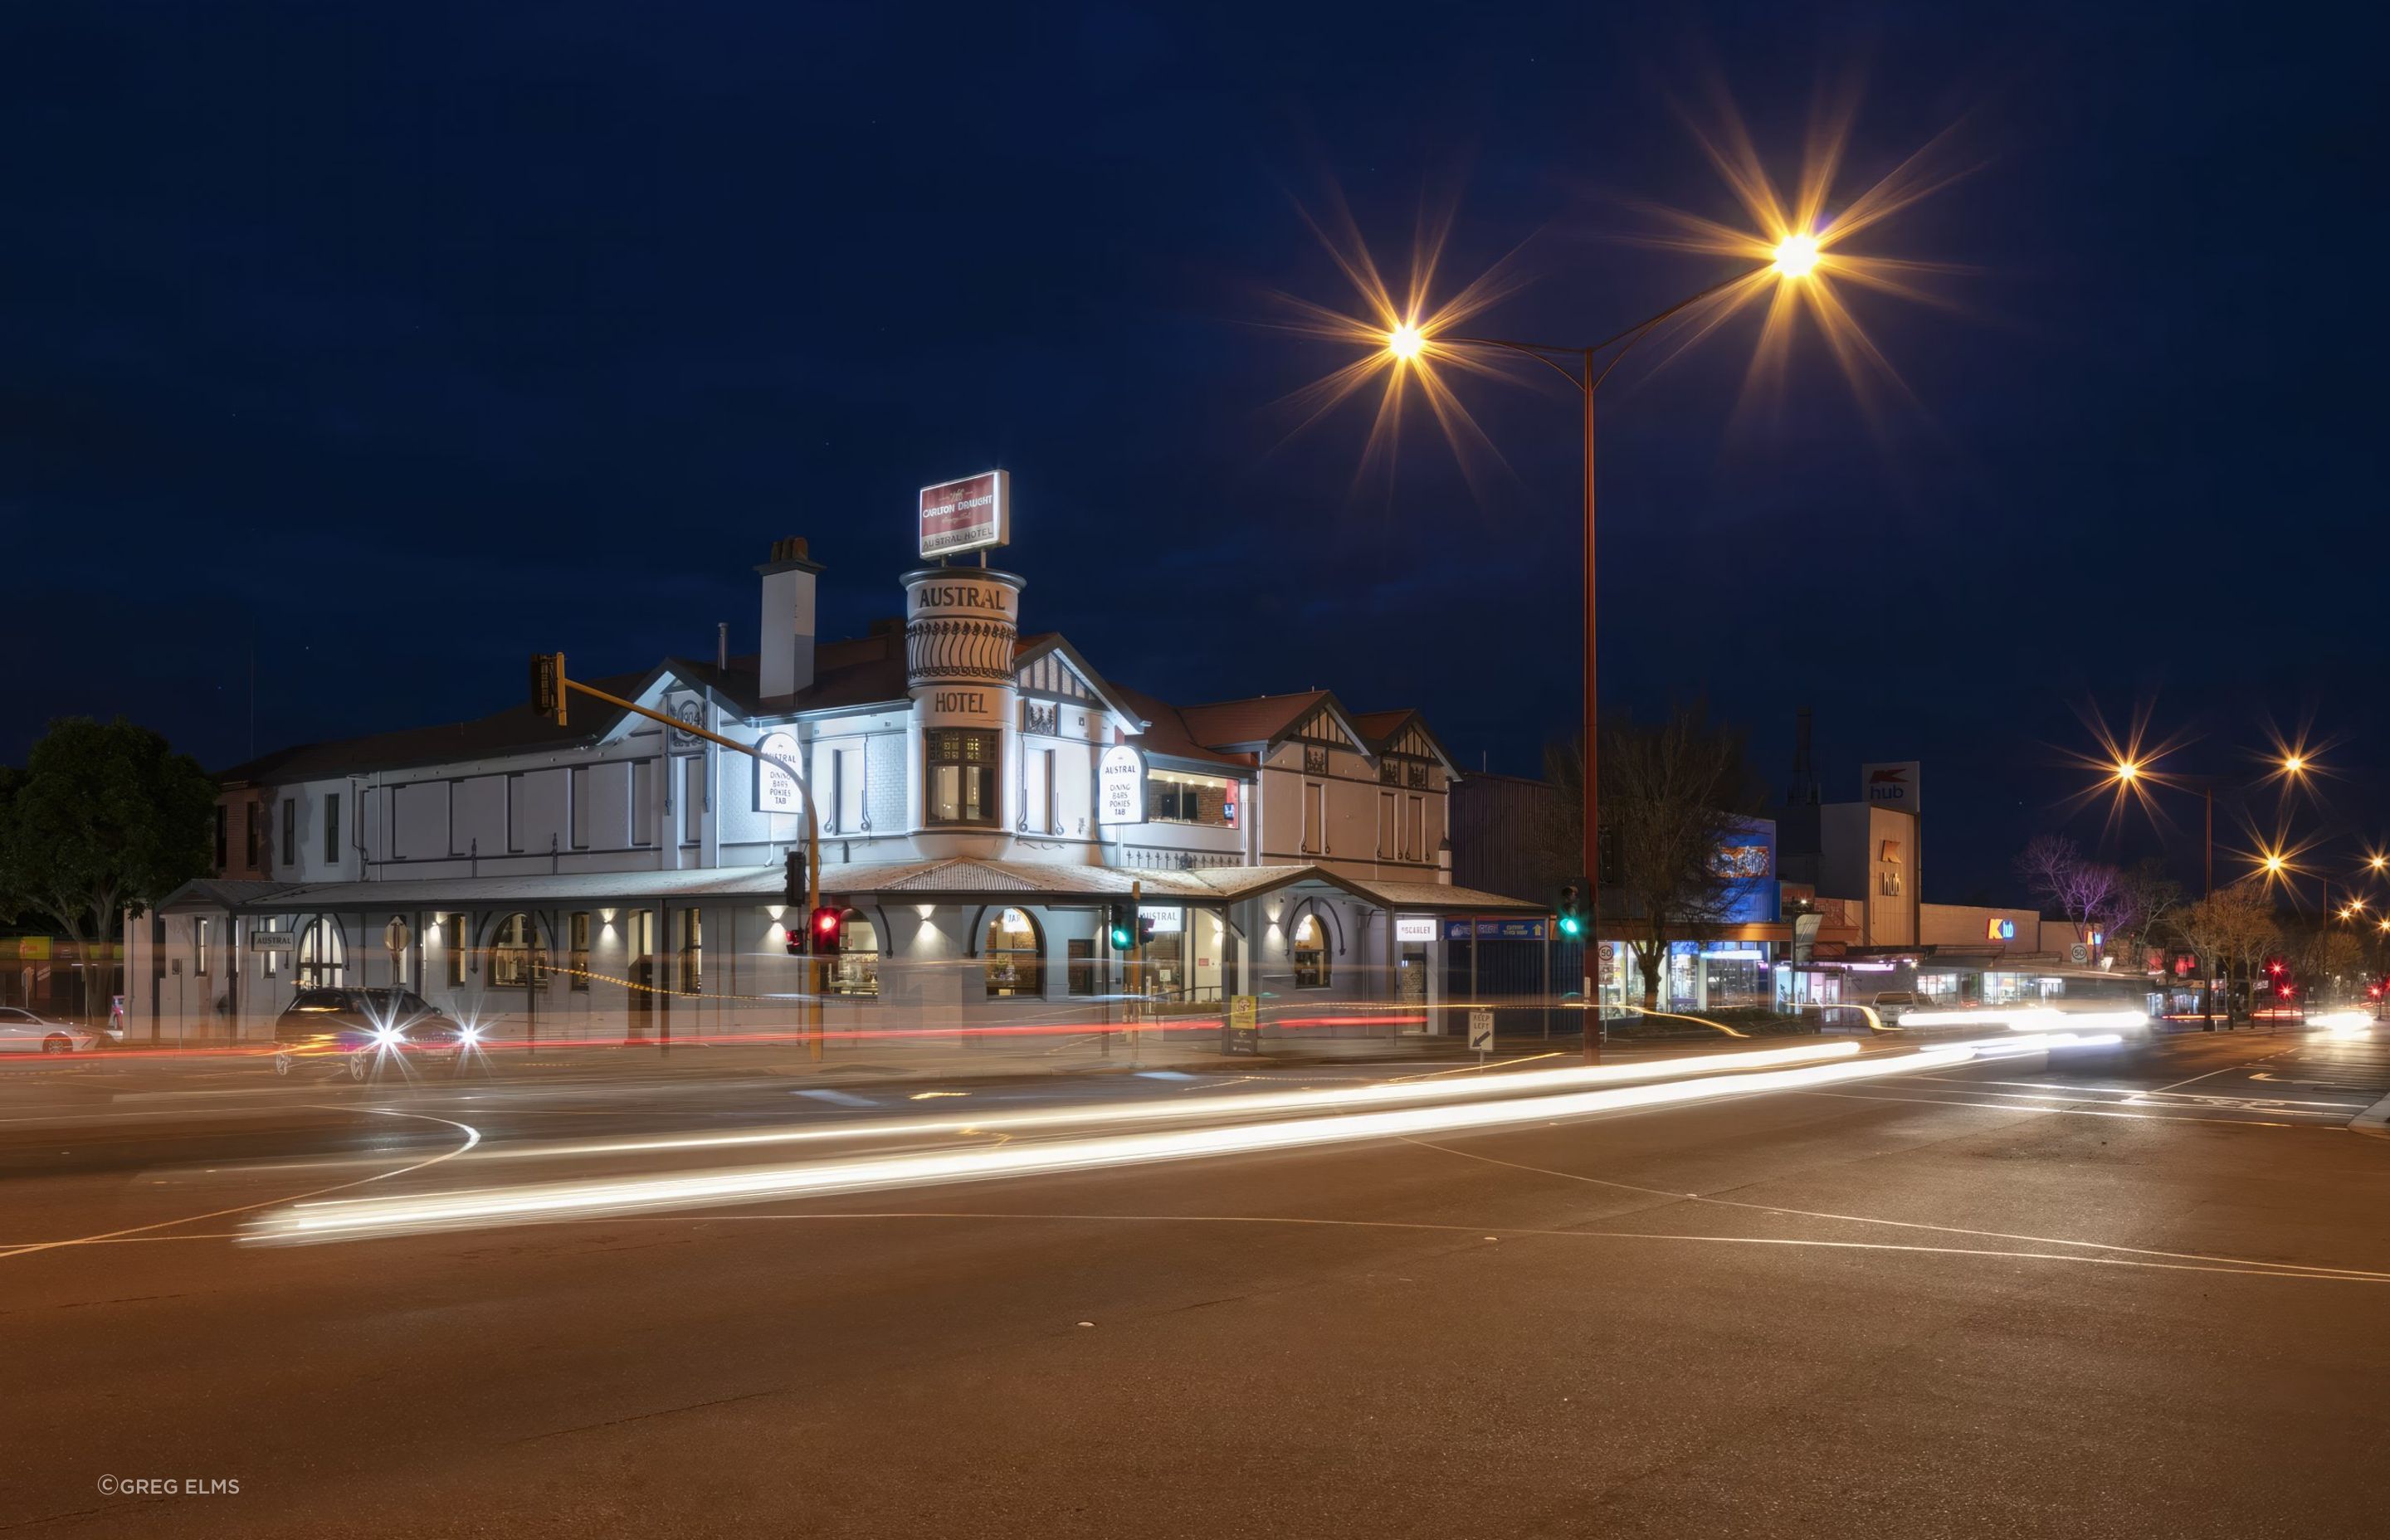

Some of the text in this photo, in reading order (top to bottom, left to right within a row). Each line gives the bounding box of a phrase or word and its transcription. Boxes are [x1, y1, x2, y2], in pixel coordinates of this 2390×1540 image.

[922, 495, 993, 518] CARLTON DRAUGHT
[923, 528, 993, 548] AUSTRAL HOTEL
[919, 587, 1006, 611] AUSTRAL
[934, 692, 988, 714] HOTEL
[1105, 765, 1136, 774] AUSTRAL
[770, 771, 791, 780] DINING
[773, 780, 788, 788] BARS
[1110, 783, 1130, 792] DINING
[769, 788, 791, 797] POKIES
[1870, 783, 1904, 800] hub
[775, 797, 787, 805] TAB
[1109, 799, 1130, 807] POKIES
[1880, 871, 1901, 897] hub
[1601, 948, 1612, 957] 50
[2074, 948, 2085, 957] 50
